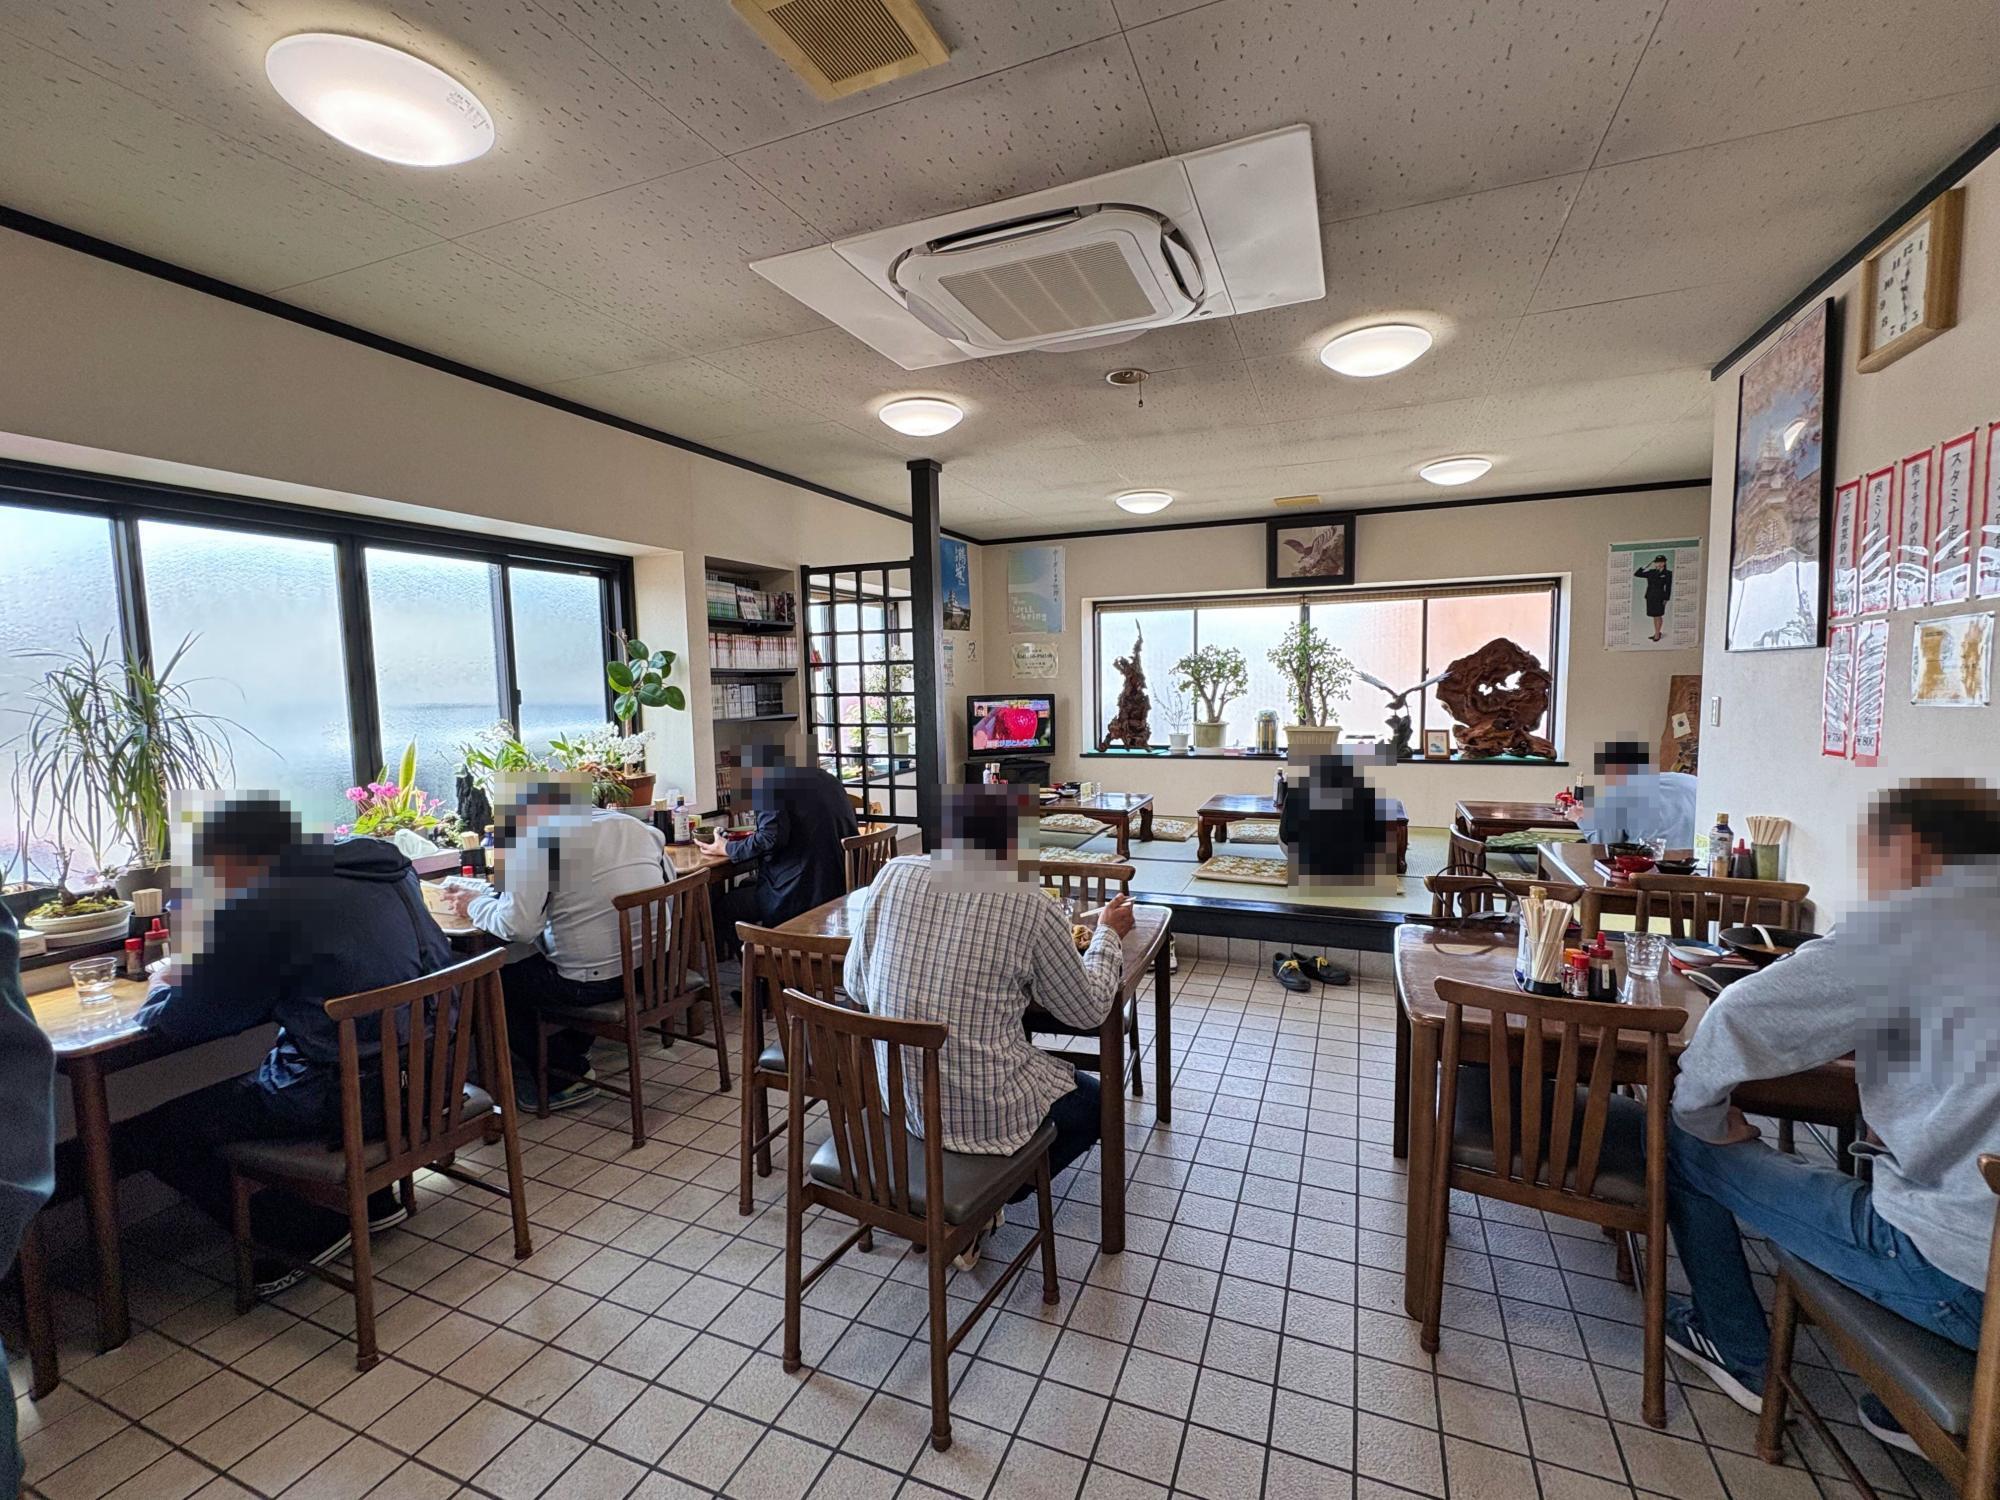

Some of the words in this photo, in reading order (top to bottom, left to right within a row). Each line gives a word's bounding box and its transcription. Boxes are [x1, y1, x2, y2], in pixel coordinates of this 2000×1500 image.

[1892, 257, 1901, 270] 11
[1884, 277, 1894, 290] 10
[1880, 300, 1886, 311] 9
[1912, 311, 1919, 321] 5
[1881, 316, 1888, 328] 8
[1900, 322, 1907, 332] 6
